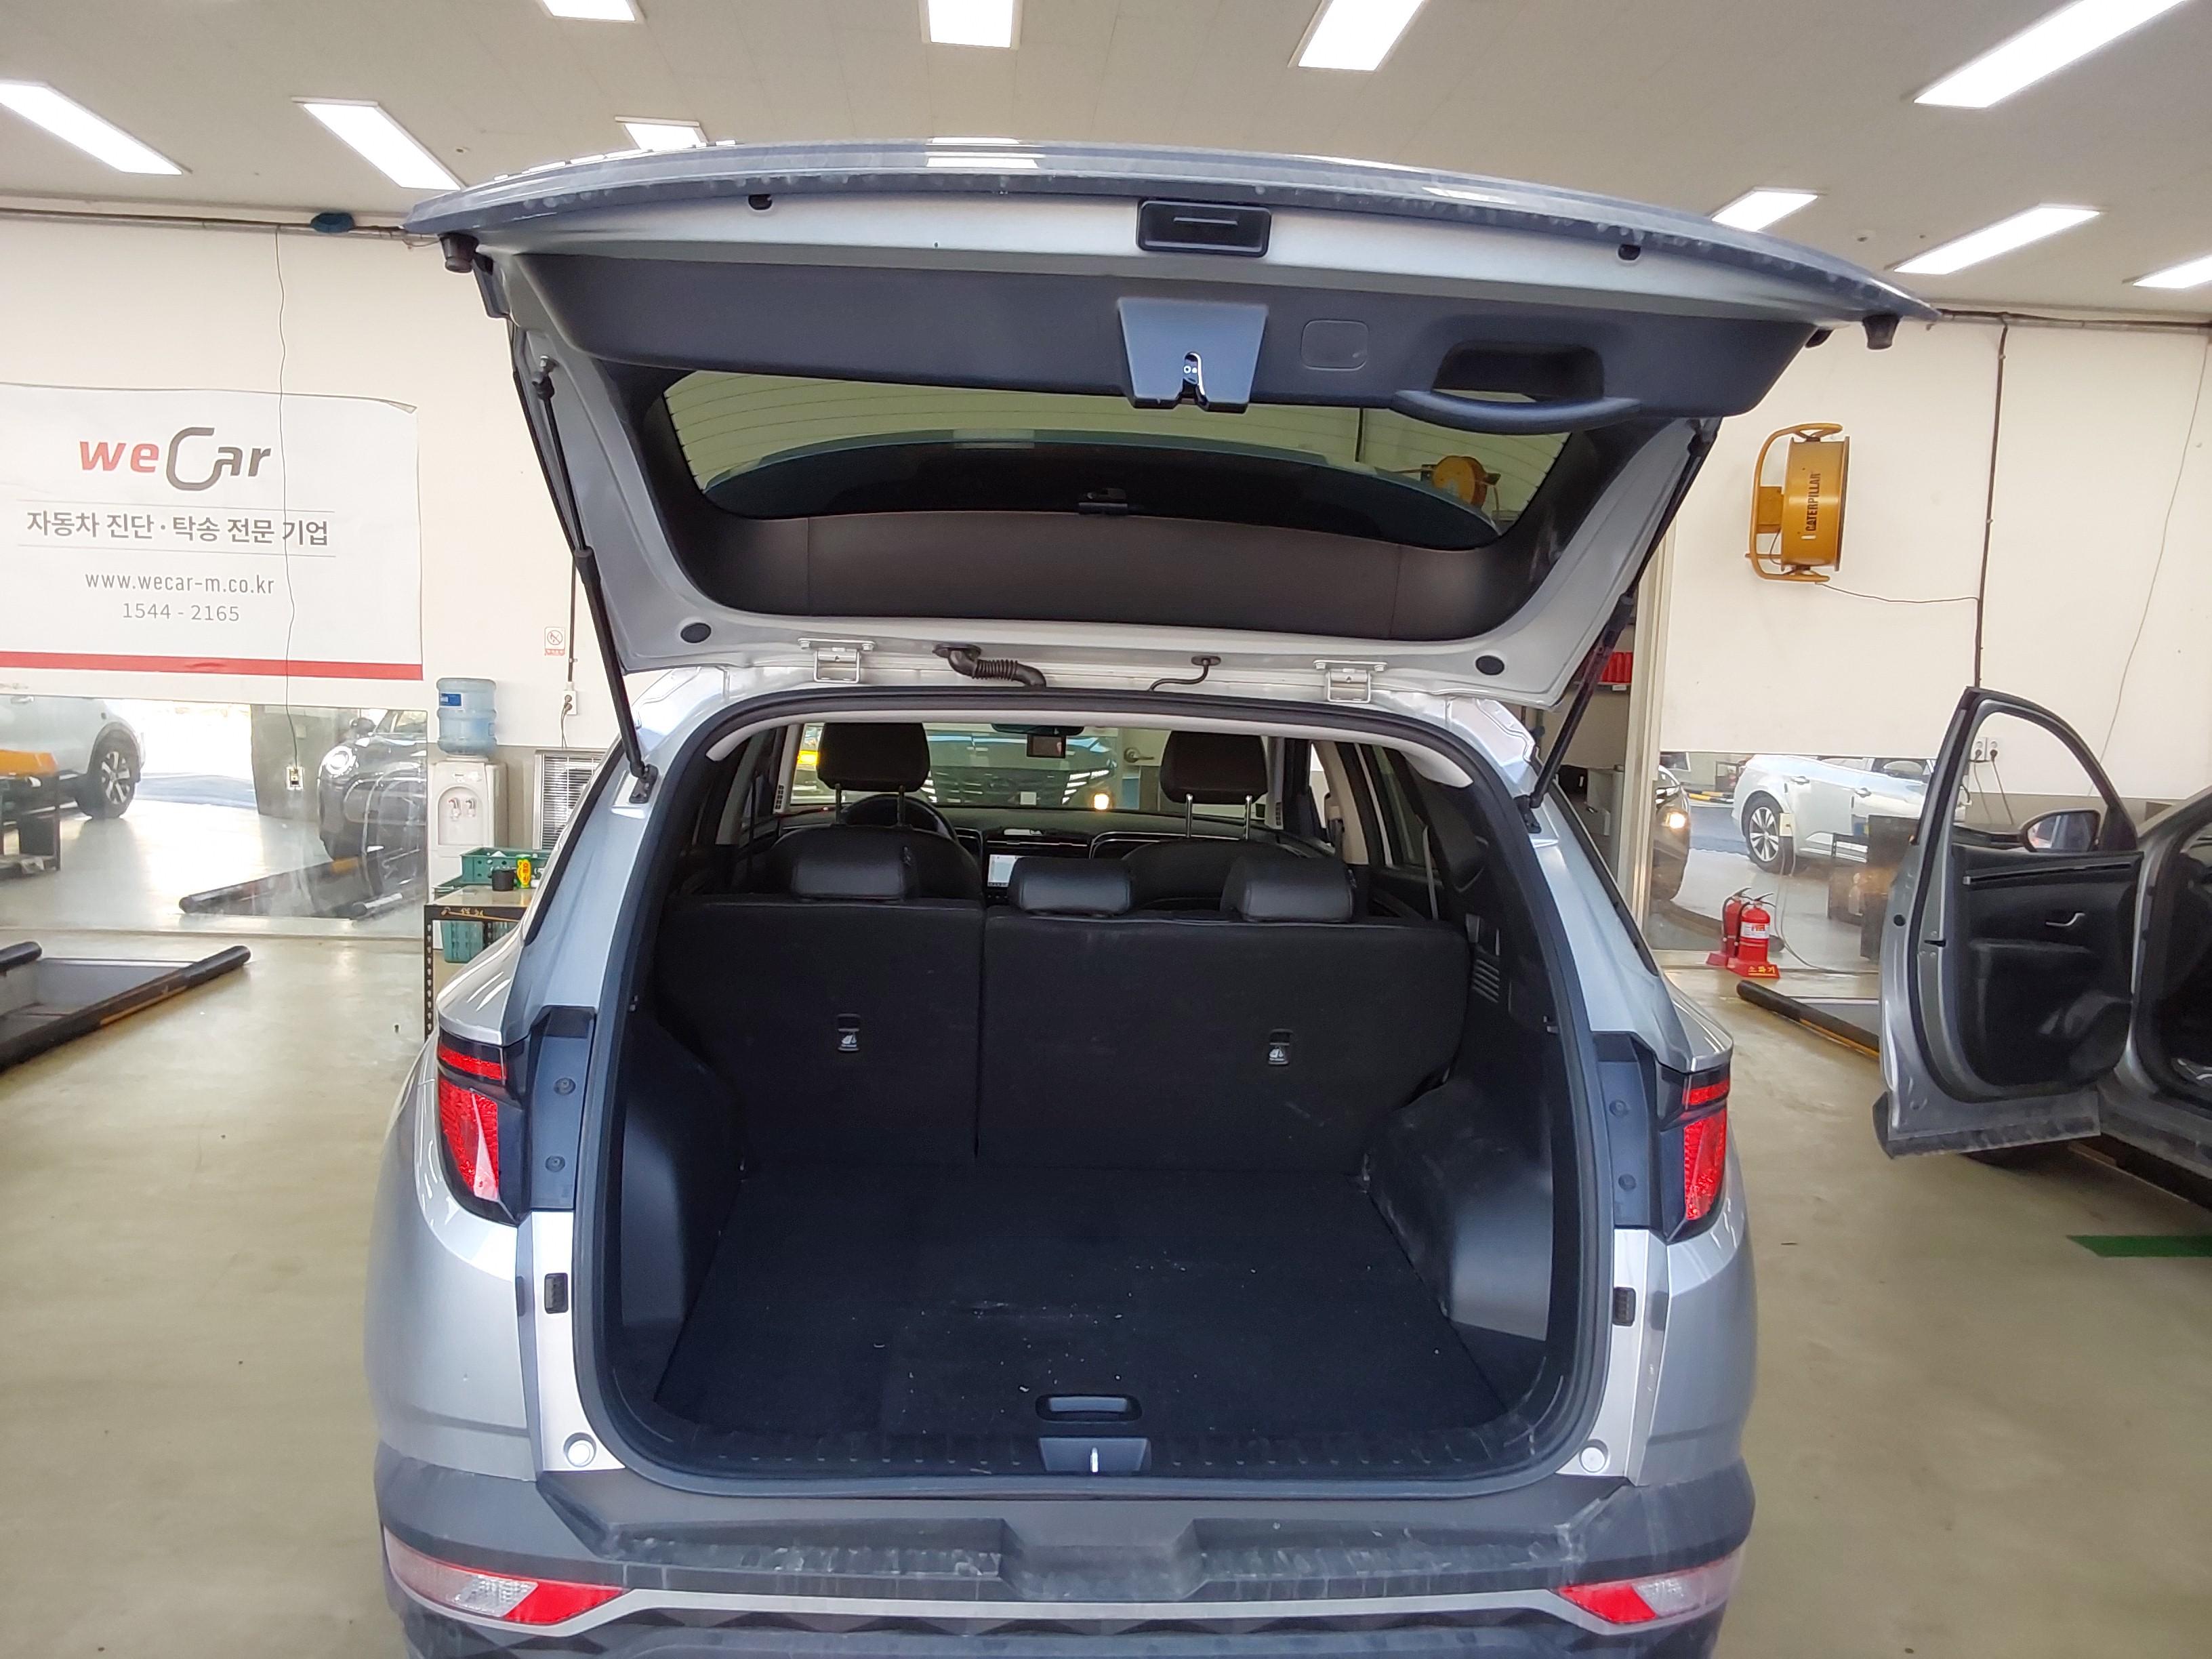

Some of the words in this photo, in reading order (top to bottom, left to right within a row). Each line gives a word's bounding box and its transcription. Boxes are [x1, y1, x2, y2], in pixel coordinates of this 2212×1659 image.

[79, 427, 271, 491] weCar
[1805, 472, 1821, 531] CATERPILLAR
[27, 510, 100, 537] 자동차
[227, 518, 275, 544] 전문
[283, 521, 329, 546] 기업
[85, 572, 274, 595] www.wecar-m.co.kr
[1748, 966, 1776, 974] 소화기
